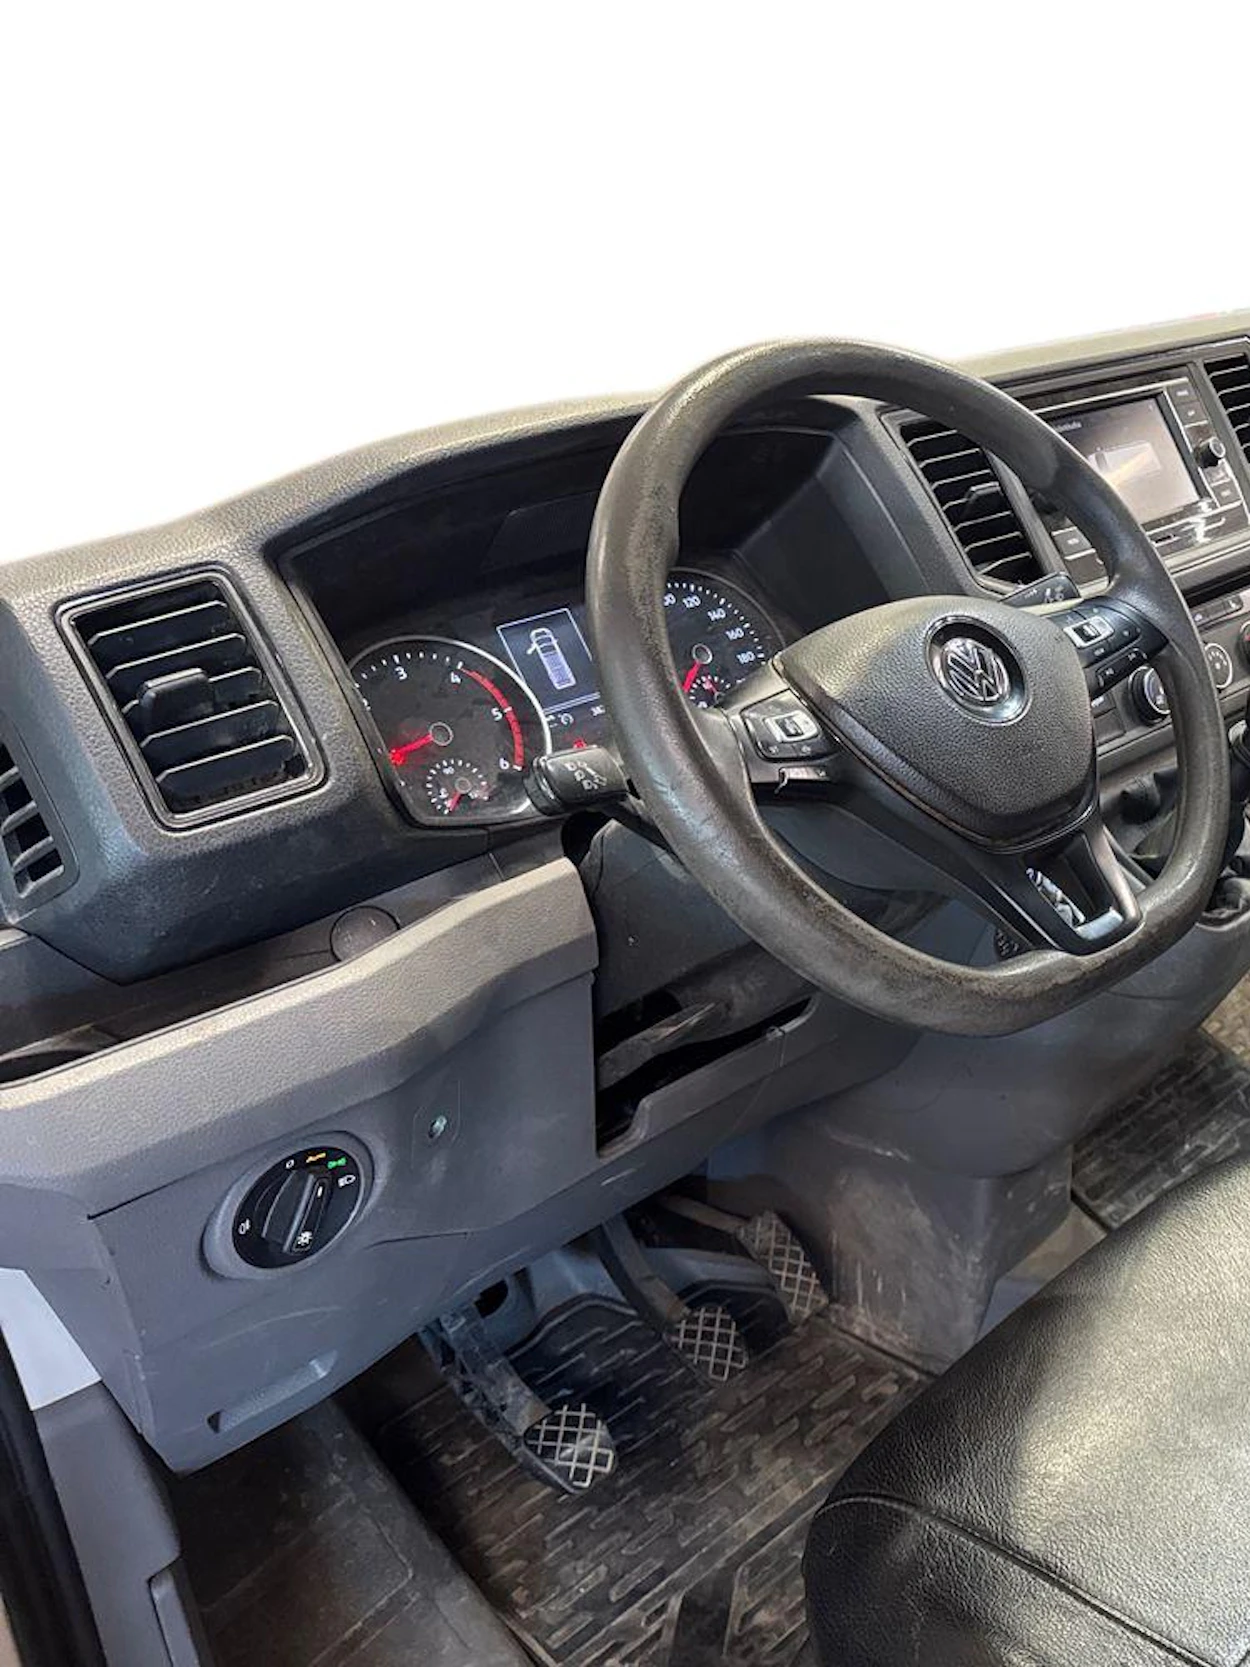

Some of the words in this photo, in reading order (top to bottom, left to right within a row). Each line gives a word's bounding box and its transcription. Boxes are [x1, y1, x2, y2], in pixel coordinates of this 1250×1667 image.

[682, 595, 701, 608] 120
[707, 608, 726, 621] 140
[725, 627, 744, 640] 160
[736, 651, 755, 664] 180
[394, 666, 408, 680] 3
[939, 637, 1011, 704] VW
[450, 672, 461, 684] 4
[491, 707, 502, 721] 5
[499, 758, 510, 770] 6
